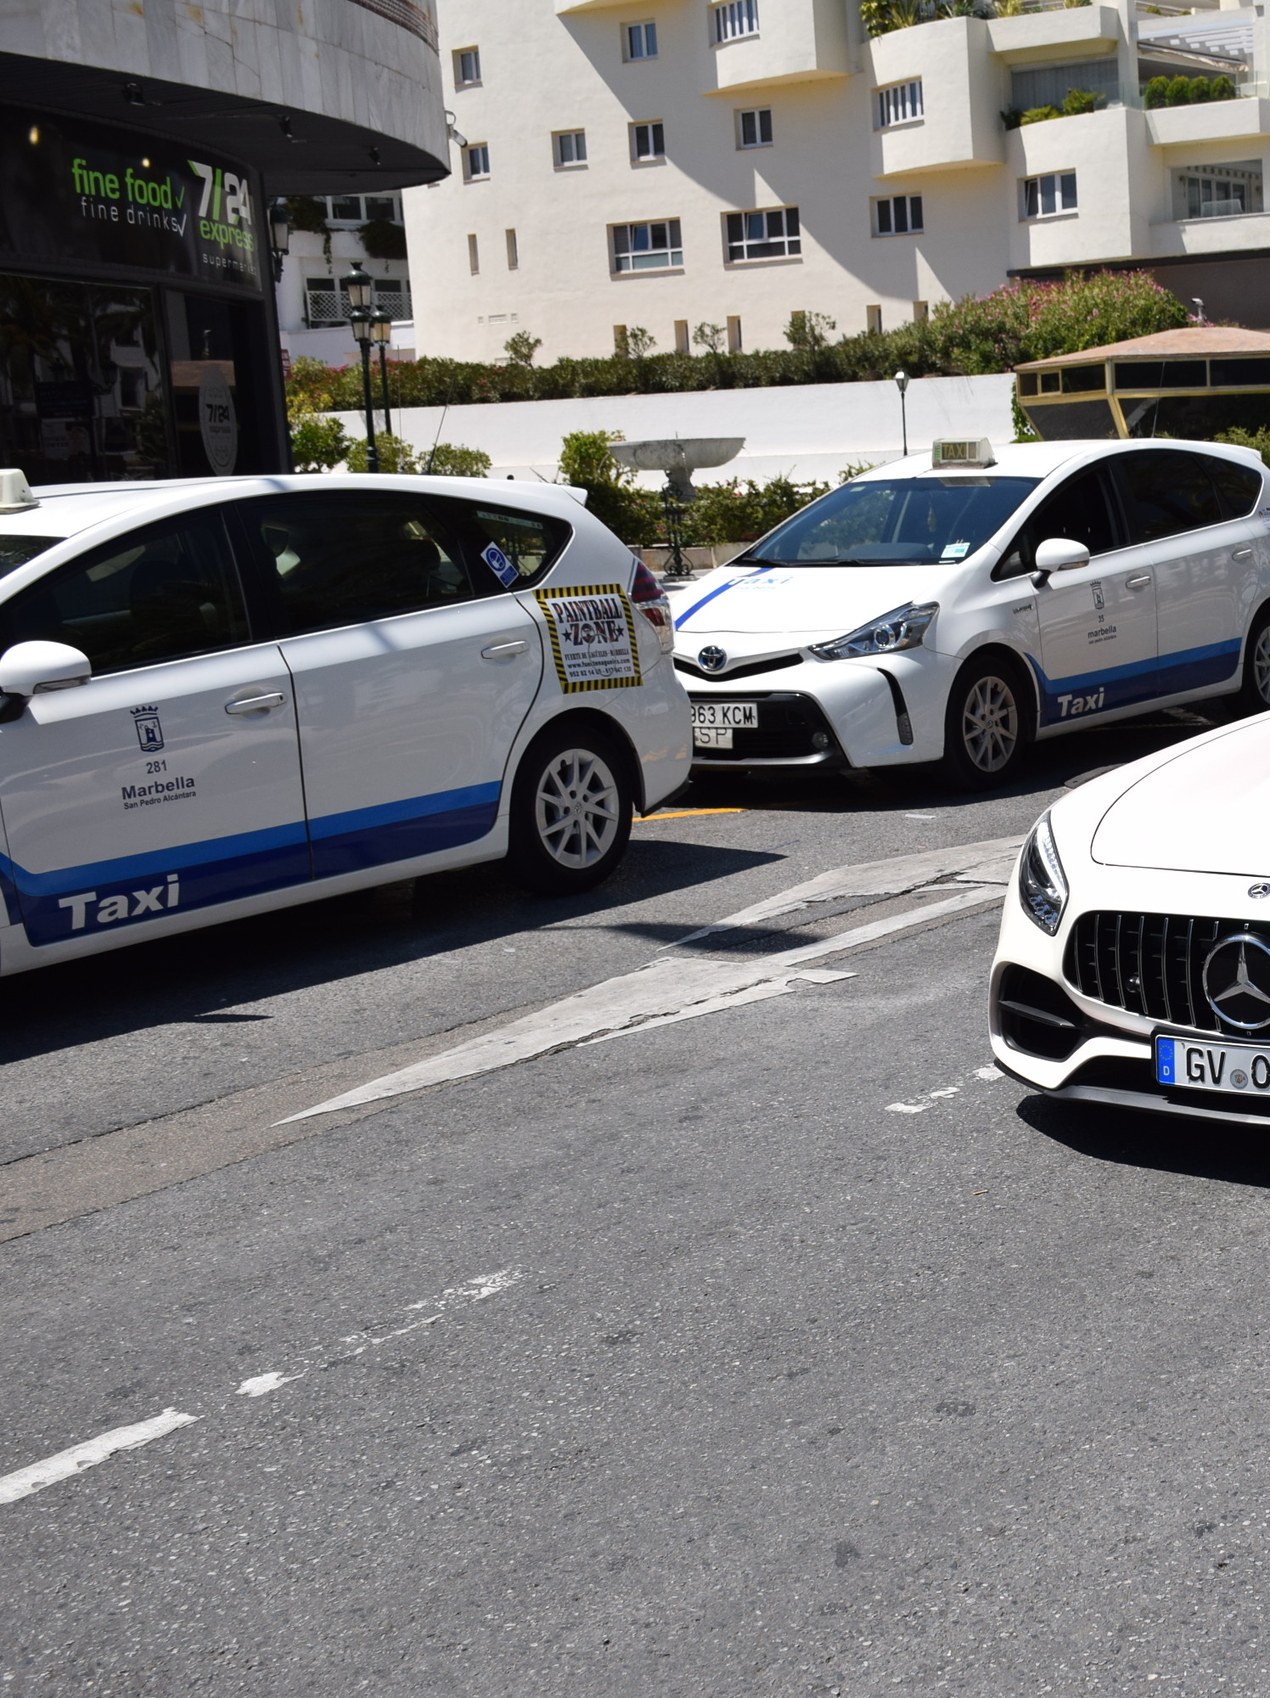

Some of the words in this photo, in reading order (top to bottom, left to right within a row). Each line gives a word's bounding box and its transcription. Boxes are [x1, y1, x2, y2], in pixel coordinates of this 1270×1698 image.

[72, 158, 120, 200] fine
[125, 168, 173, 210] food
[81, 196, 119, 222] fine
[126, 205, 179, 232] drinks
[200, 219, 255, 252] express
[942, 443, 967, 459] TAXI
[552, 598, 622, 623] PAINTBALL
[570, 620, 618, 646] ZONE
[1087, 625, 1117, 639] marbella
[1057, 686, 1105, 718] Taxi
[722, 706, 753, 725] KCM
[700, 728, 728, 744] SP
[146, 759, 168, 775] 281
[121, 776, 195, 800] Marbella
[124, 802, 139, 810] San
[140, 797, 162, 807] Pedro
[162, 790, 197, 803] Alcántara
[58, 873, 180, 931] Taxi
[1163, 1065, 1171, 1077] D
[1186, 1047, 1226, 1086] GV
